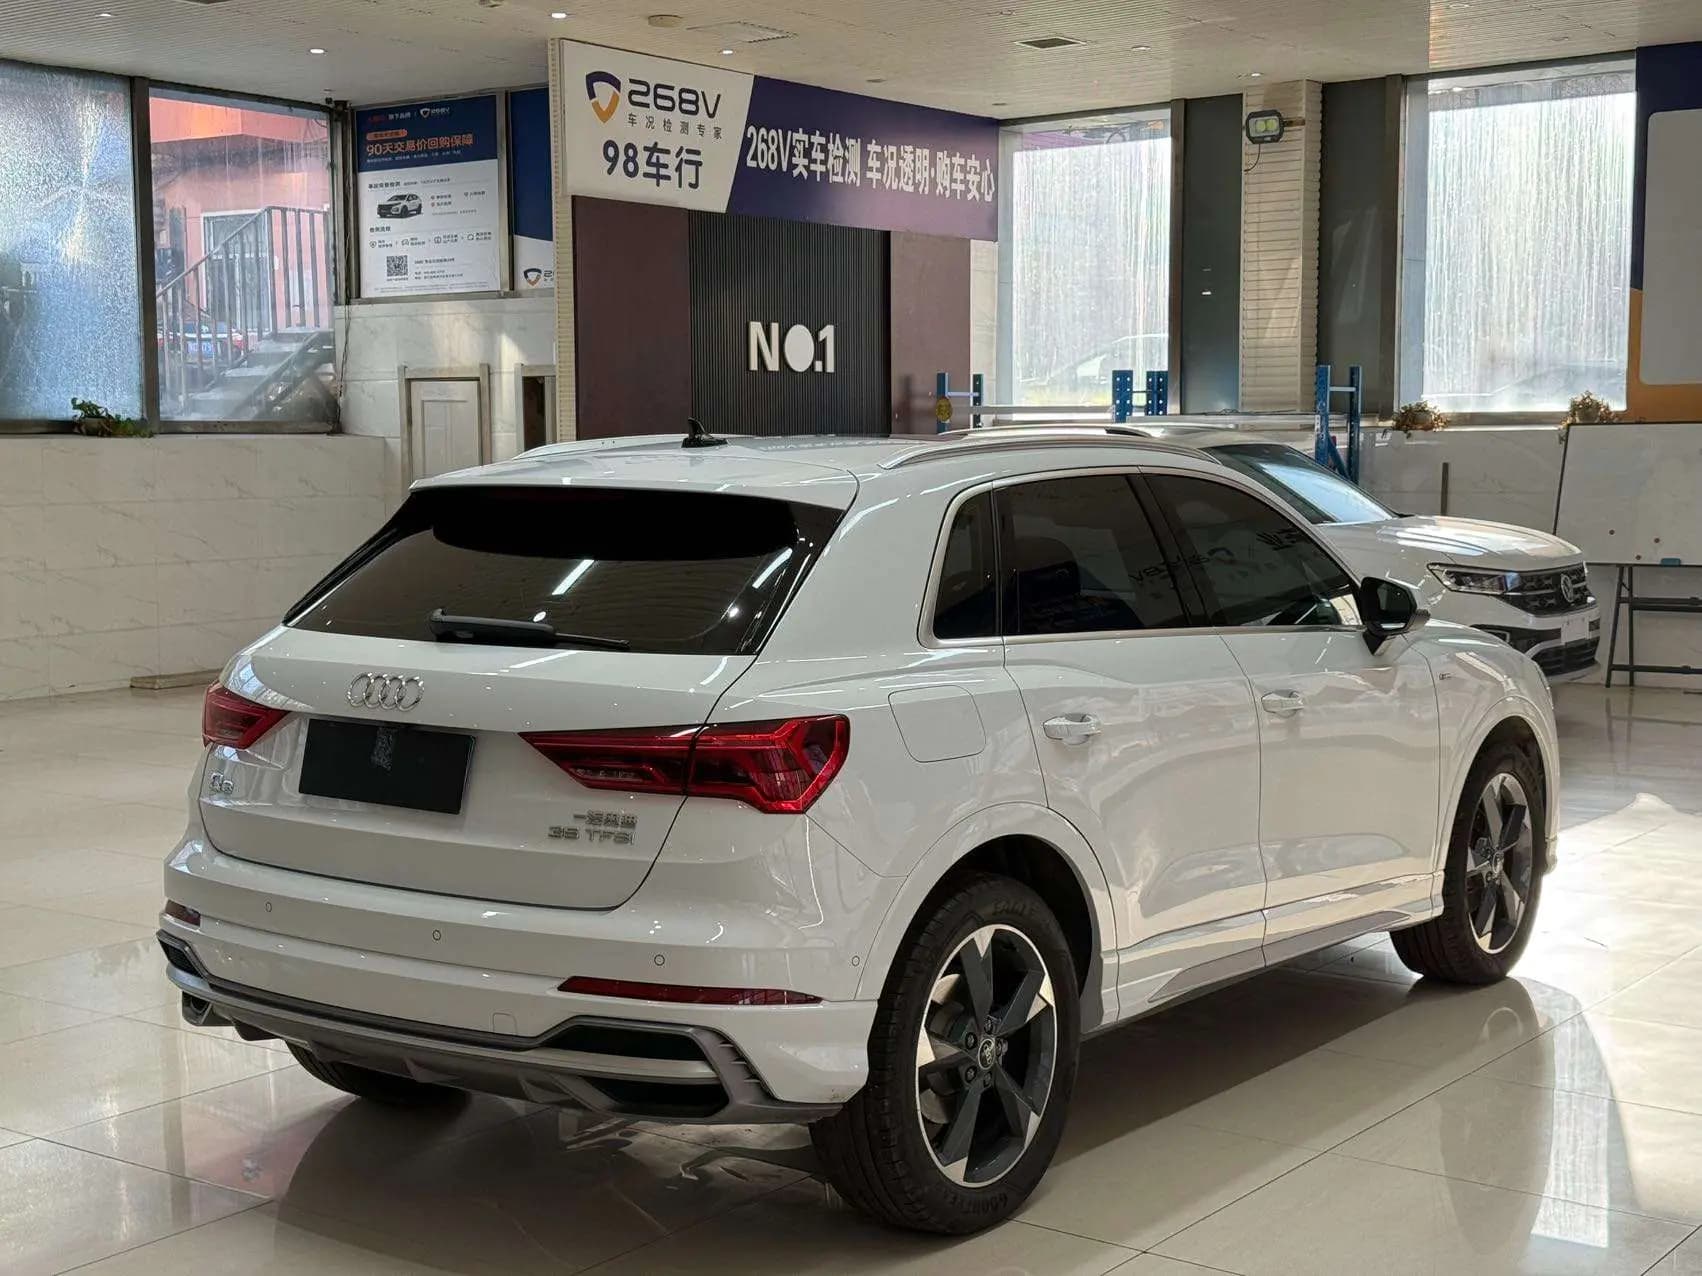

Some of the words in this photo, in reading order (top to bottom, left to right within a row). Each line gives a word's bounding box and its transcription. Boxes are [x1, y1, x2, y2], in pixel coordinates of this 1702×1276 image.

[628, 78, 721, 119] 268V
[366, 133, 474, 156] 90天交易价回购保障
[627, 112, 722, 140] 车况检测专家
[602, 138, 703, 190] 98车行
[746, 125, 861, 187] 268V实车检测
[748, 321, 835, 374] NO.1
[584, 828, 636, 845] TFSI
